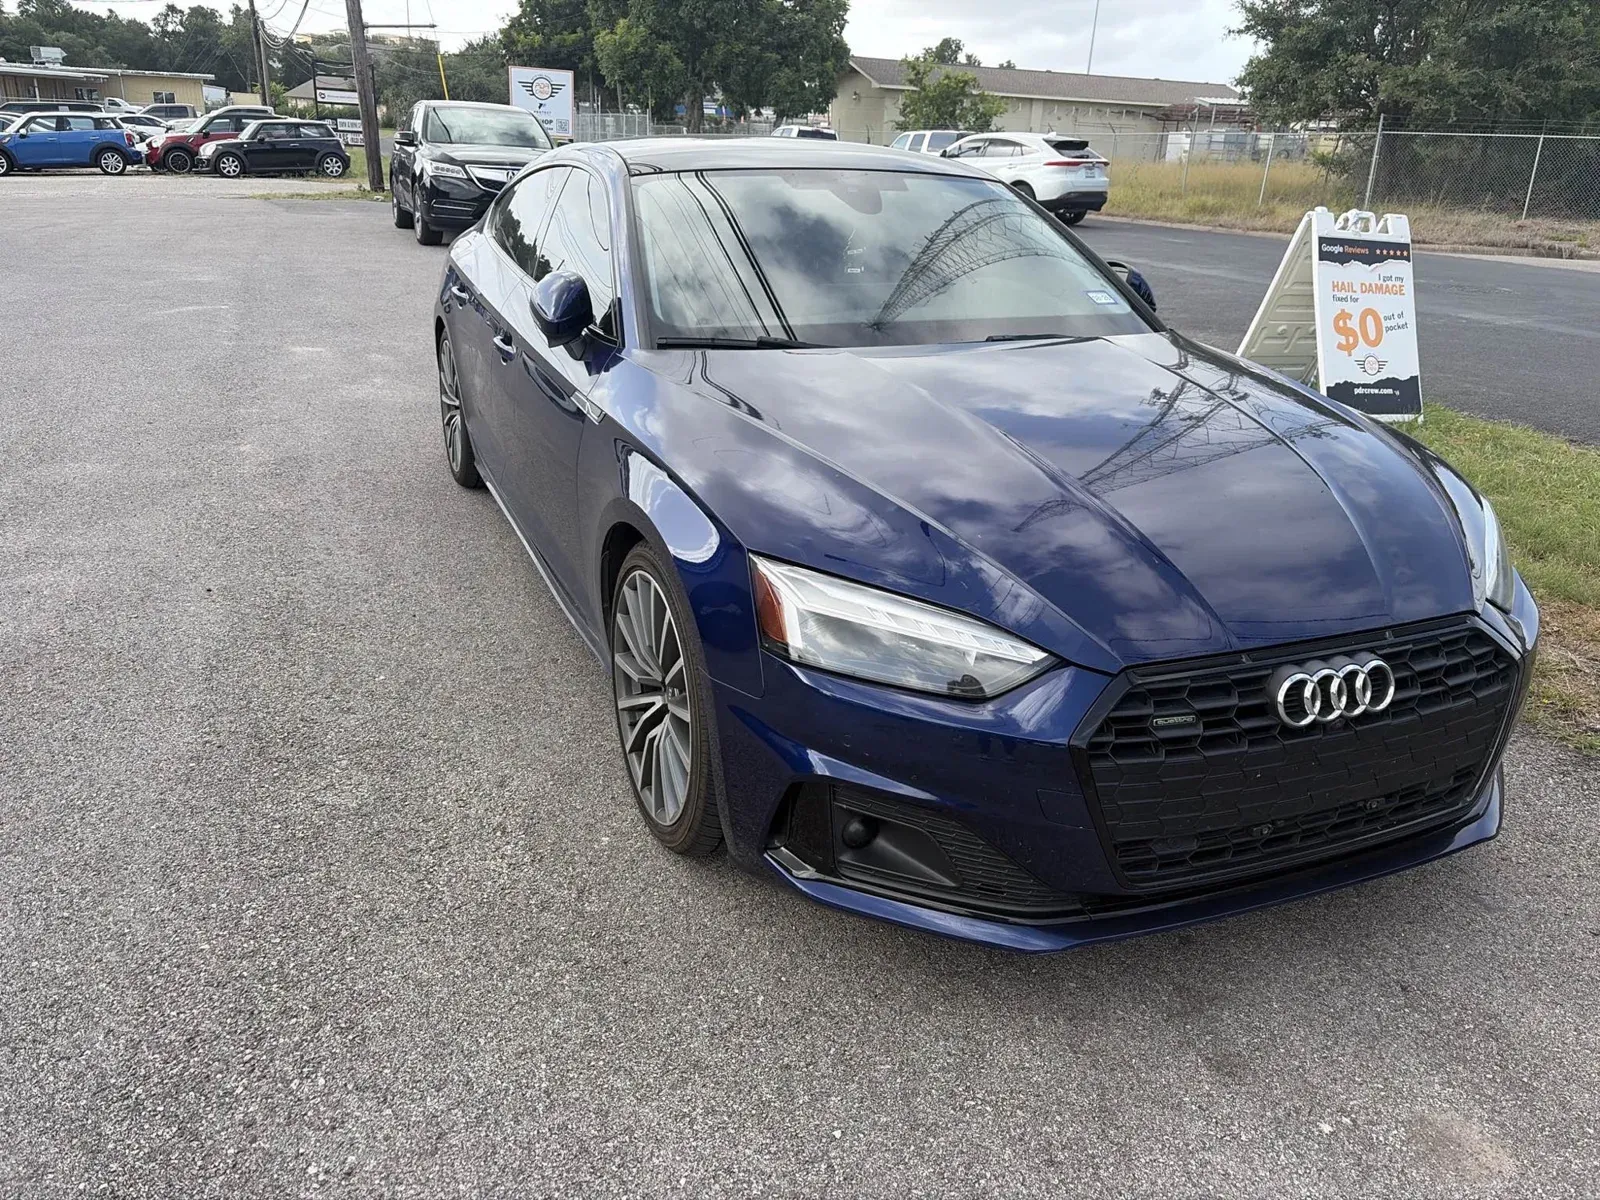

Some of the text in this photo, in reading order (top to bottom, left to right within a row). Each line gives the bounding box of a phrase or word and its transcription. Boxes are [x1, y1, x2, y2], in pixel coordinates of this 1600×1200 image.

[1321, 243, 1369, 255] Google Reviews
[1378, 273, 1381, 281] I
[1382, 275, 1393, 283] got
[1332, 280, 1405, 296] HAIL DAMAGE
[1332, 294, 1359, 303] fixed for
[1383, 311, 1404, 321] out of
[1333, 307, 1383, 357] $0
[1385, 322, 1408, 333] pocket
[1354, 386, 1393, 395] pdrcrew.com
